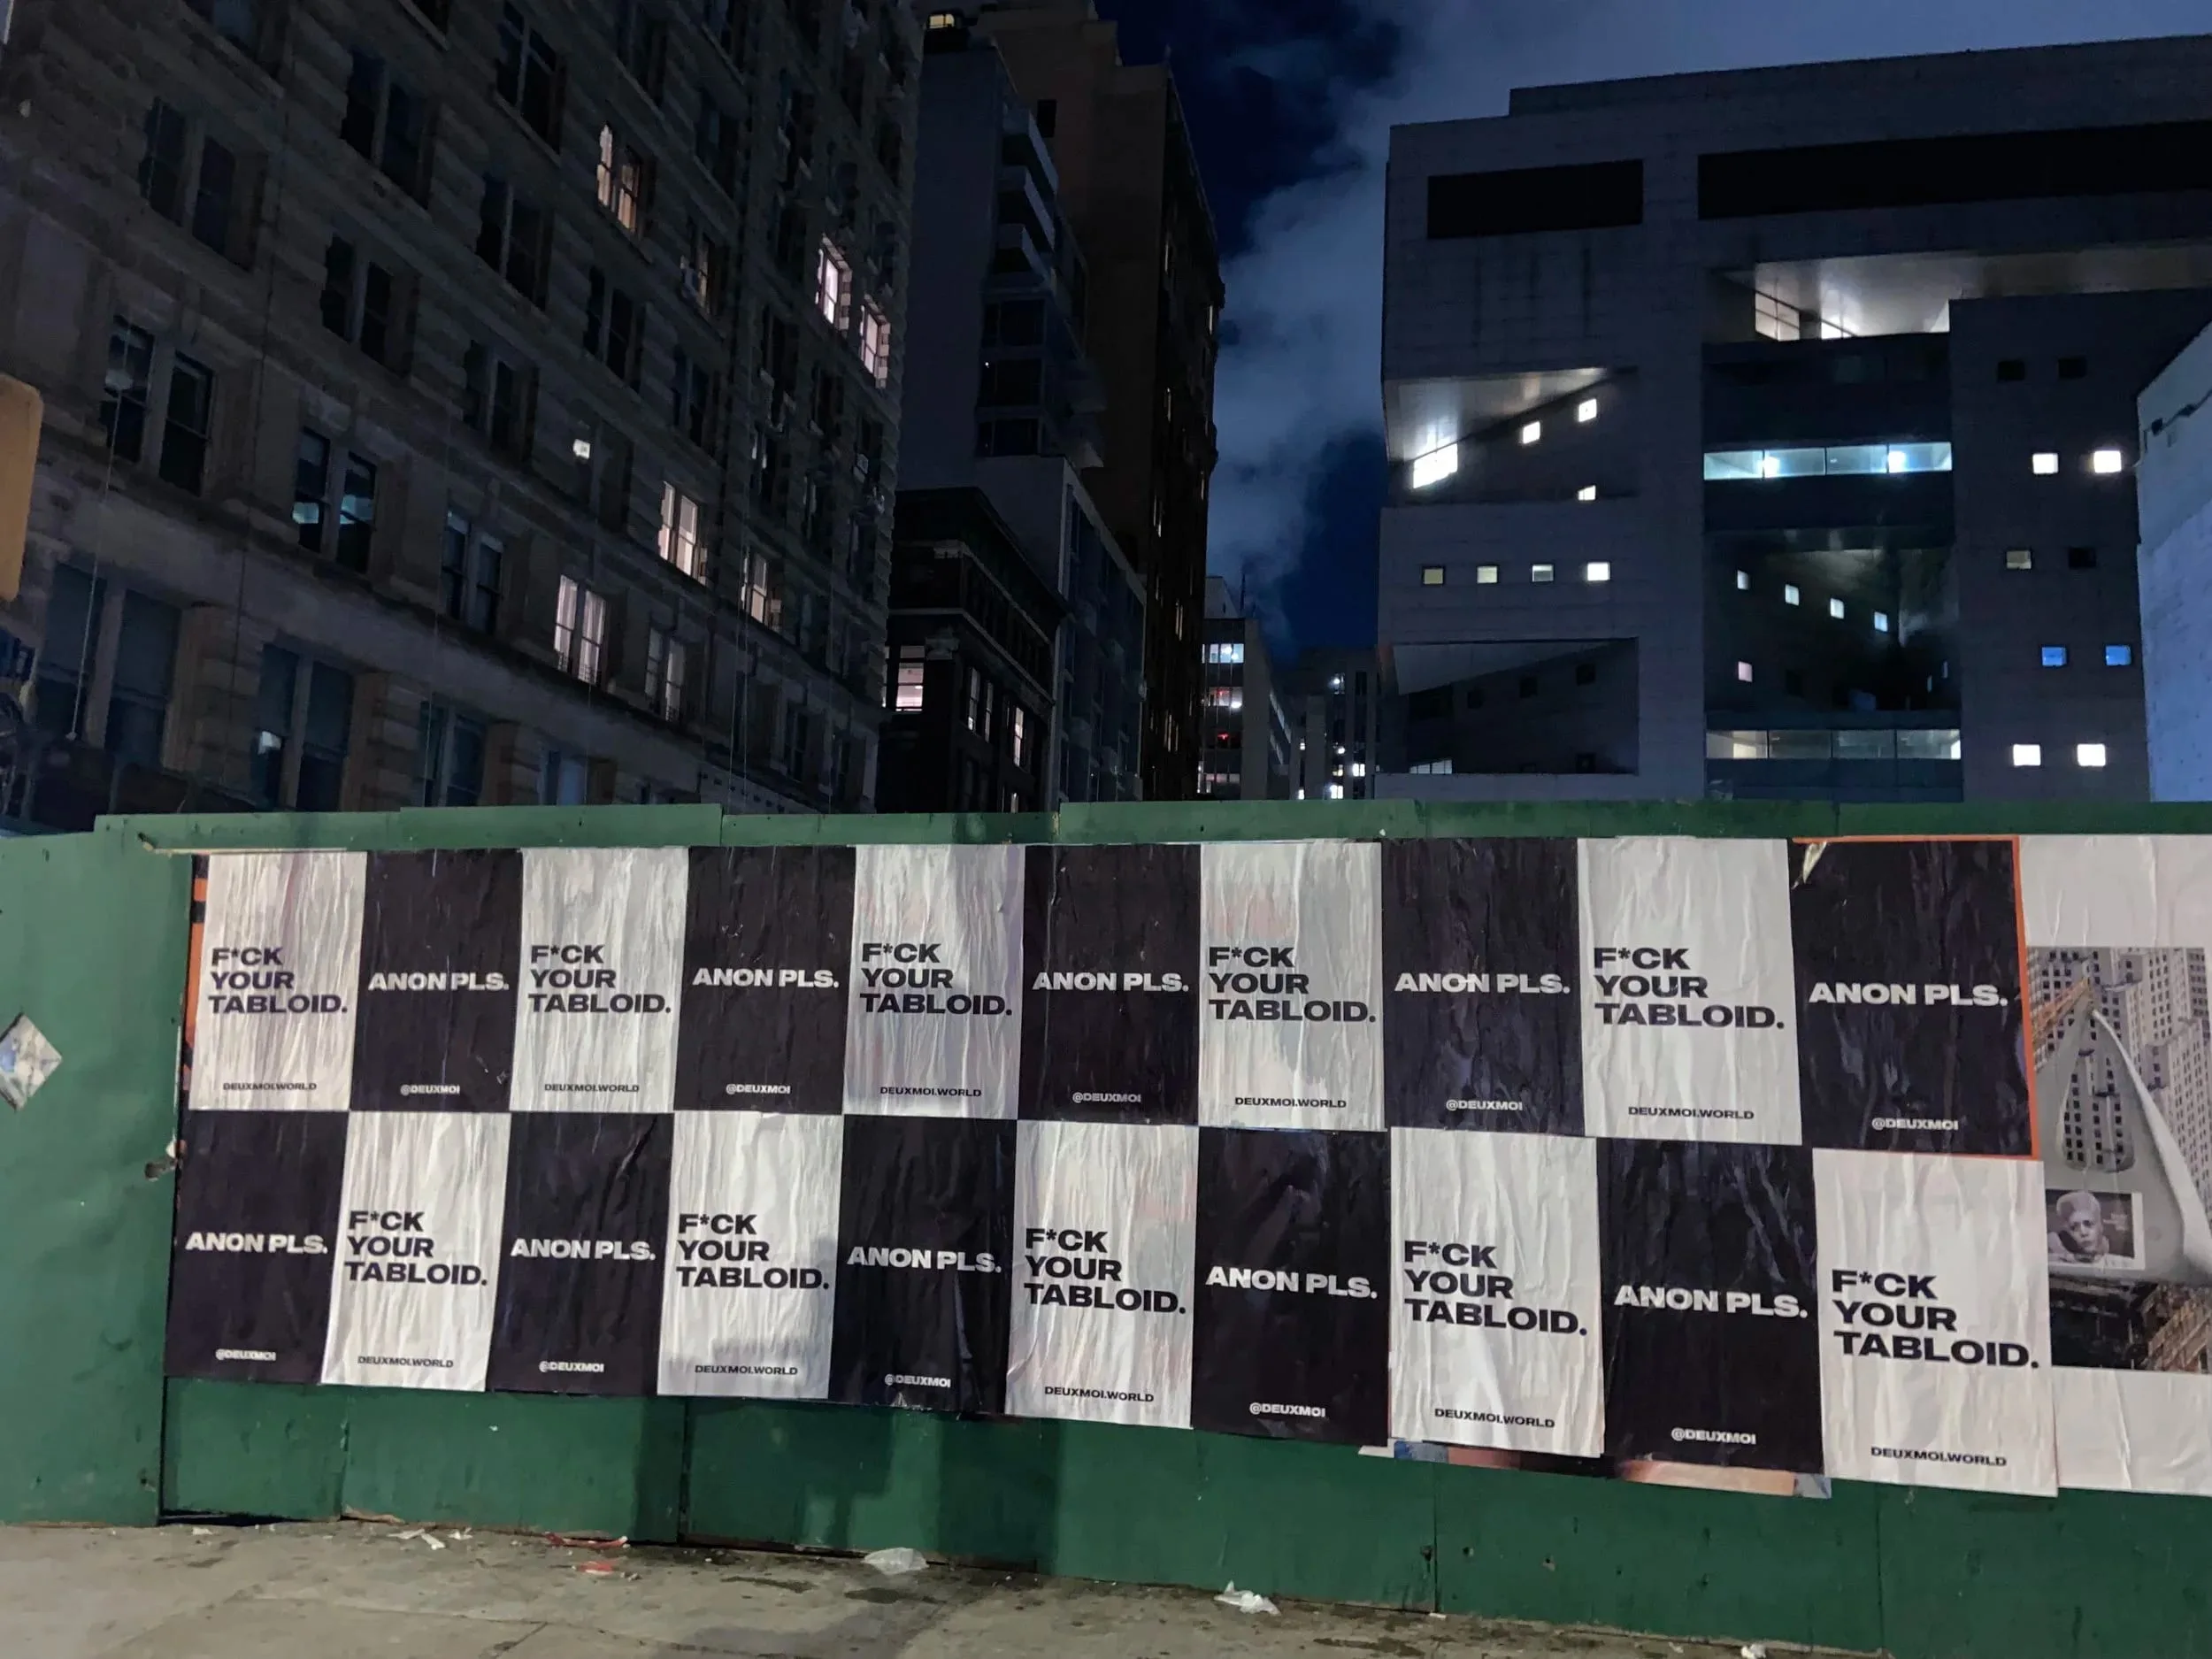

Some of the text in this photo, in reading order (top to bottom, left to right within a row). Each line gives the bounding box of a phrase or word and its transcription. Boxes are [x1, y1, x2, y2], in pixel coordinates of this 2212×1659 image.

[210, 971, 294, 990] YOUR
[368, 972, 509, 991] ANON PLS.
[529, 970, 616, 989] YOUR
[693, 969, 839, 988] ANON PLS.
[861, 969, 953, 988] YOUR
[1033, 972, 1189, 992] ANON PLS.
[1210, 973, 1309, 994] YOUR
[1395, 973, 1570, 995] ANON PLS.
[1594, 975, 1708, 999] YOUR
[208, 995, 347, 1014] TABLOID.
[528, 994, 671, 1013] TABLOID.
[1809, 982, 2008, 1006] ANON PLS.
[860, 995, 1012, 1016] TABLOID.
[1209, 1000, 1376, 1022] TABLOID.
[1594, 1003, 1784, 1030] TABLOID.
[400, 1085, 460, 1094] @DEUXMOI
[726, 1084, 790, 1094] @DEUXMOI
[1072, 1092, 1141, 1103] @DEUXMOI
[1446, 1099, 1523, 1111] @DEUXMOI
[1871, 1117, 1959, 1131] @DEUXMOI
[185, 1233, 327, 1254] ANON PLS.
[346, 1237, 434, 1258] YOUR
[510, 1240, 655, 1260] ANON PLS.
[677, 1240, 770, 1262] YOUR
[847, 1248, 1002, 1272] ANON PLS.
[1025, 1256, 1121, 1281] YOUR
[344, 1262, 488, 1286] TABLOID.
[676, 1266, 829, 1290] TABLOID.
[1206, 1267, 1377, 1299] ANON PLS.
[1404, 1270, 1513, 1299] YOUR
[1025, 1283, 1186, 1314] TABLOID.
[1615, 1285, 1807, 1318] ANON PLS.
[1404, 1299, 1587, 1336] TABLOID.
[1833, 1301, 1956, 1332] YOUR
[216, 1348, 276, 1361] @DEUXMOI
[1833, 1331, 2039, 1369] TABLOID.
[538, 1361, 603, 1372] @DEUXMOI
[885, 1375, 951, 1388] @DEUXMOI
[1249, 1402, 1325, 1417] @DEUXMOI
[1671, 1428, 1756, 1444] @DEUXMOI
